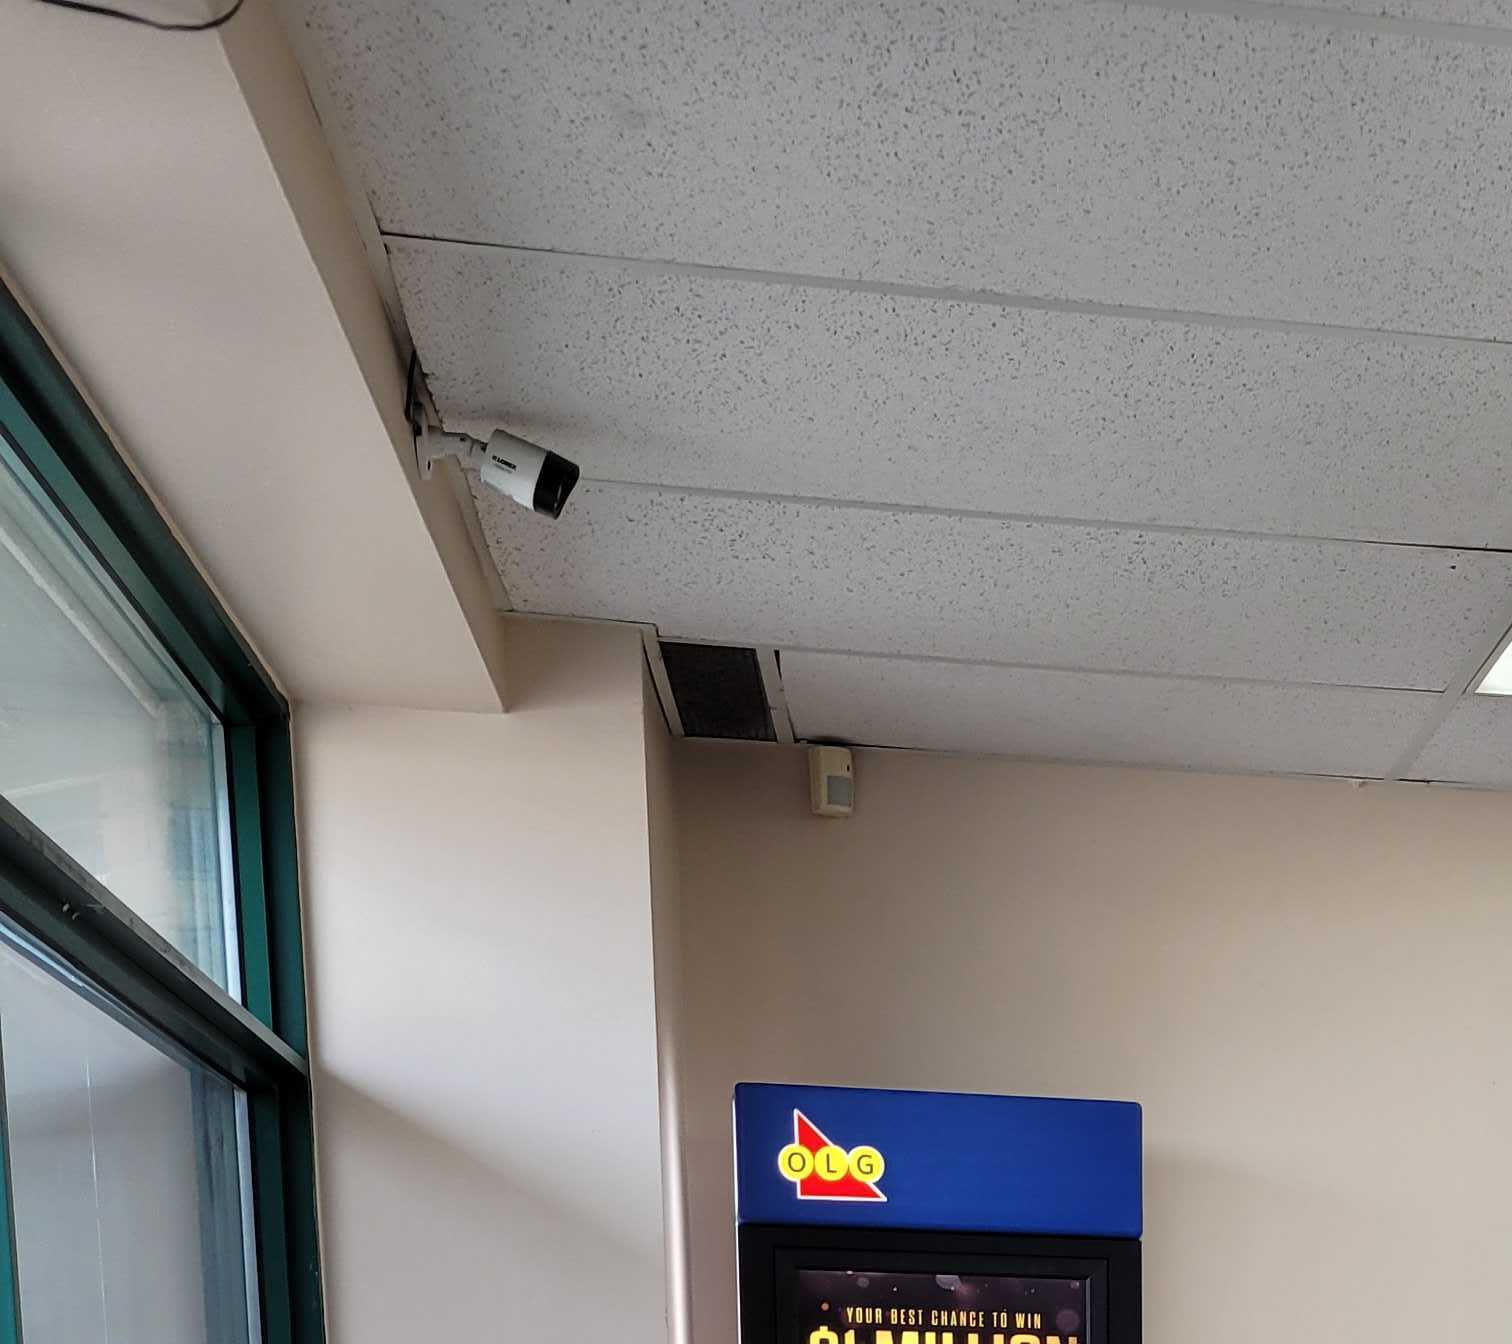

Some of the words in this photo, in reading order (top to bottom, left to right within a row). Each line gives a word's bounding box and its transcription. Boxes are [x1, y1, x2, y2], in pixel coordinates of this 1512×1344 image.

[787, 1152, 875, 1177] OLG
[846, 1307, 883, 1324] YOUR
[890, 1309, 923, 1326] BEST
[931, 1310, 985, 1328] CHANCE
[992, 1311, 1008, 1329] TO
[1015, 1313, 1041, 1330] WIN
